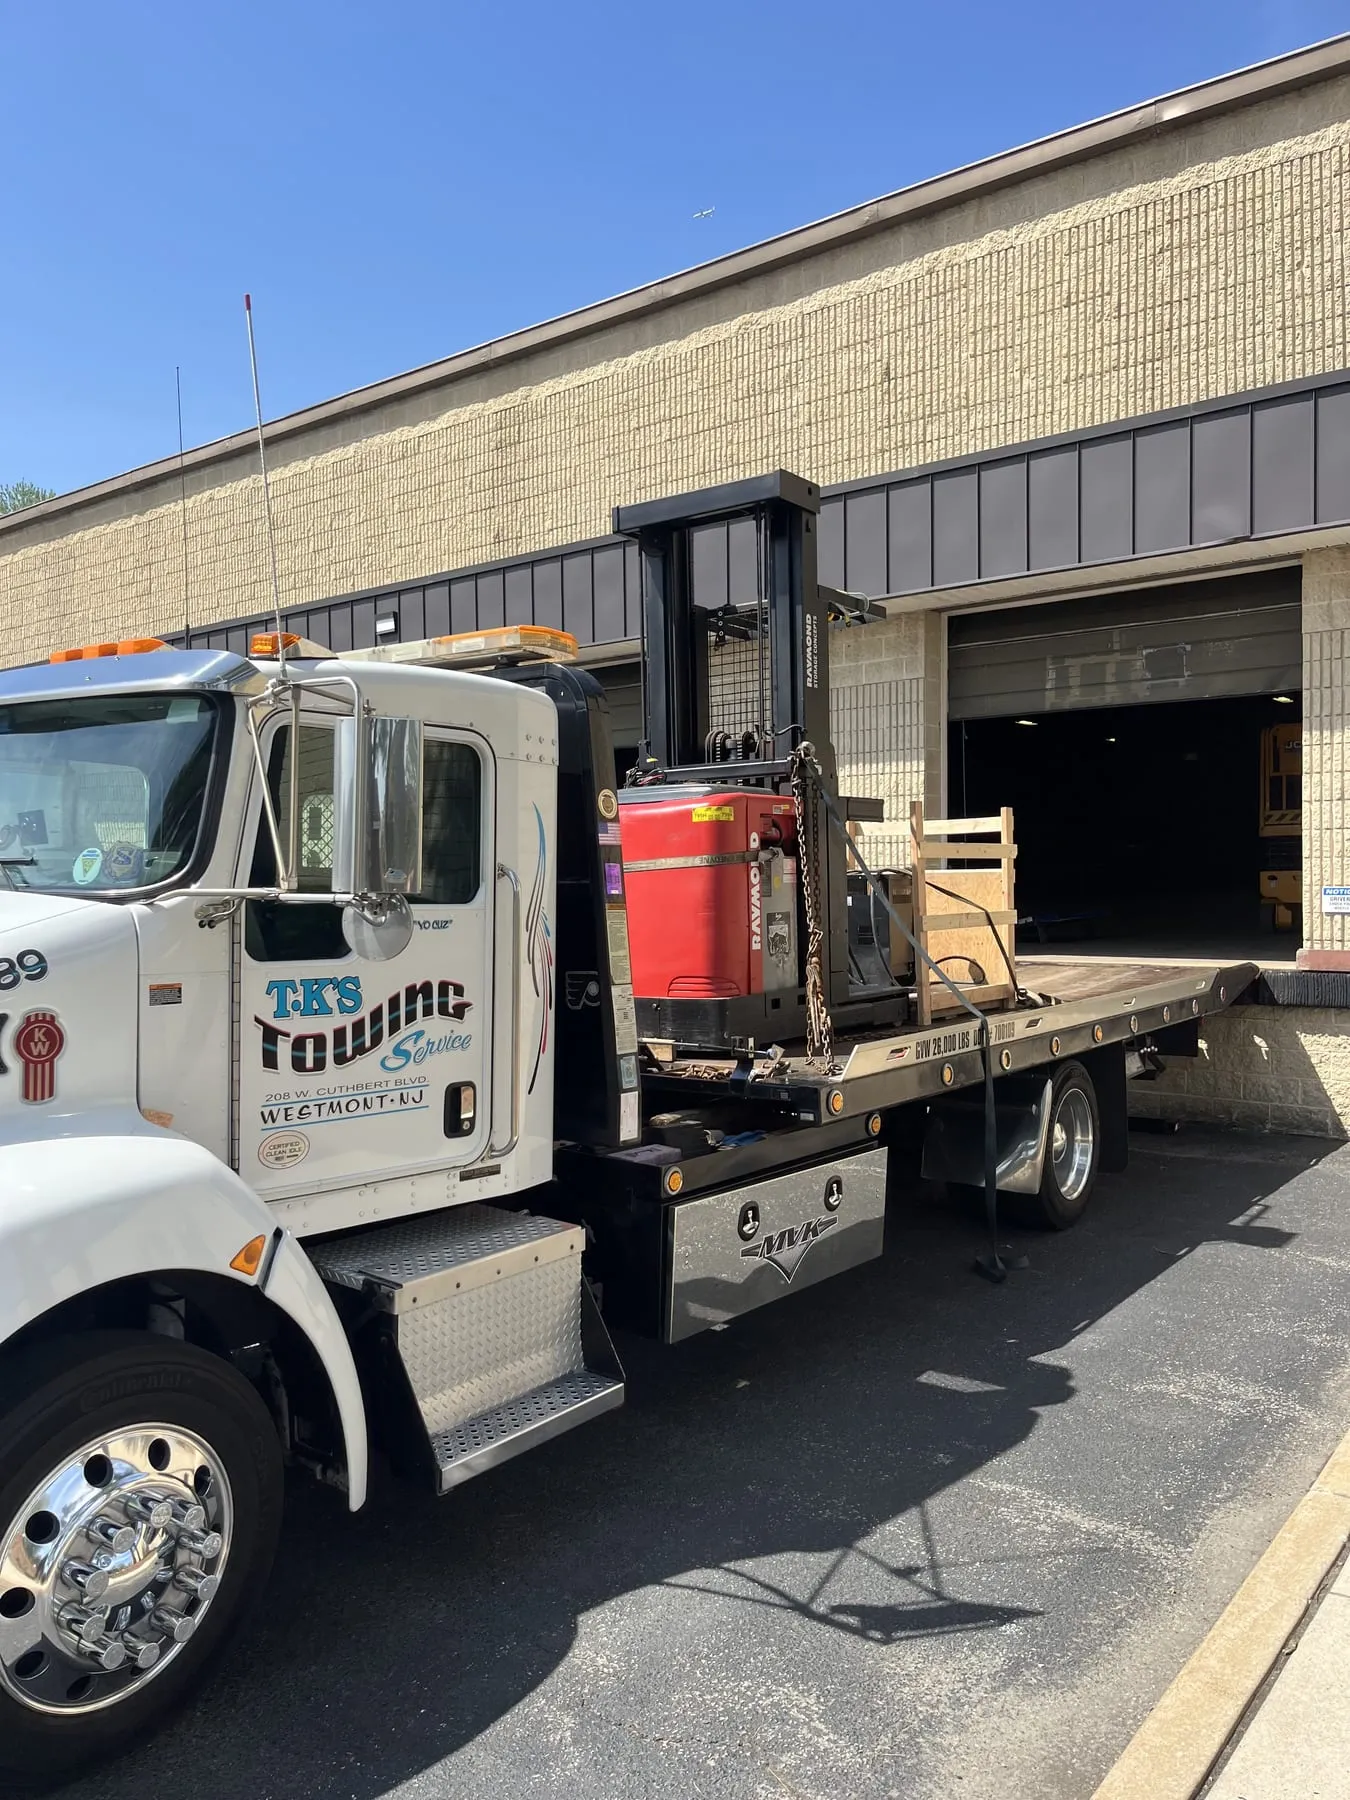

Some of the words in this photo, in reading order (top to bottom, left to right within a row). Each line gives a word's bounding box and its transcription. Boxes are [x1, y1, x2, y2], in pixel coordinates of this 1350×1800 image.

[805, 613, 813, 688] RAYMOND
[750, 831, 761, 950] RAYMOD
[0, 949, 48, 991] 89
[379, 1029, 473, 1072] Service
[915, 1039, 931, 1060] GVW
[932, 1033, 956, 1057] 26,000
[958, 1030, 970, 1049] LBS
[265, 1093, 291, 1102] 208
[294, 1089, 312, 1099] W.
[316, 1080, 392, 1096] CUTHBERT
[394, 1075, 430, 1087] BLVD.
[268, 1141, 300, 1150] CERTIFIED
[758, 1216, 824, 1258] MVK
